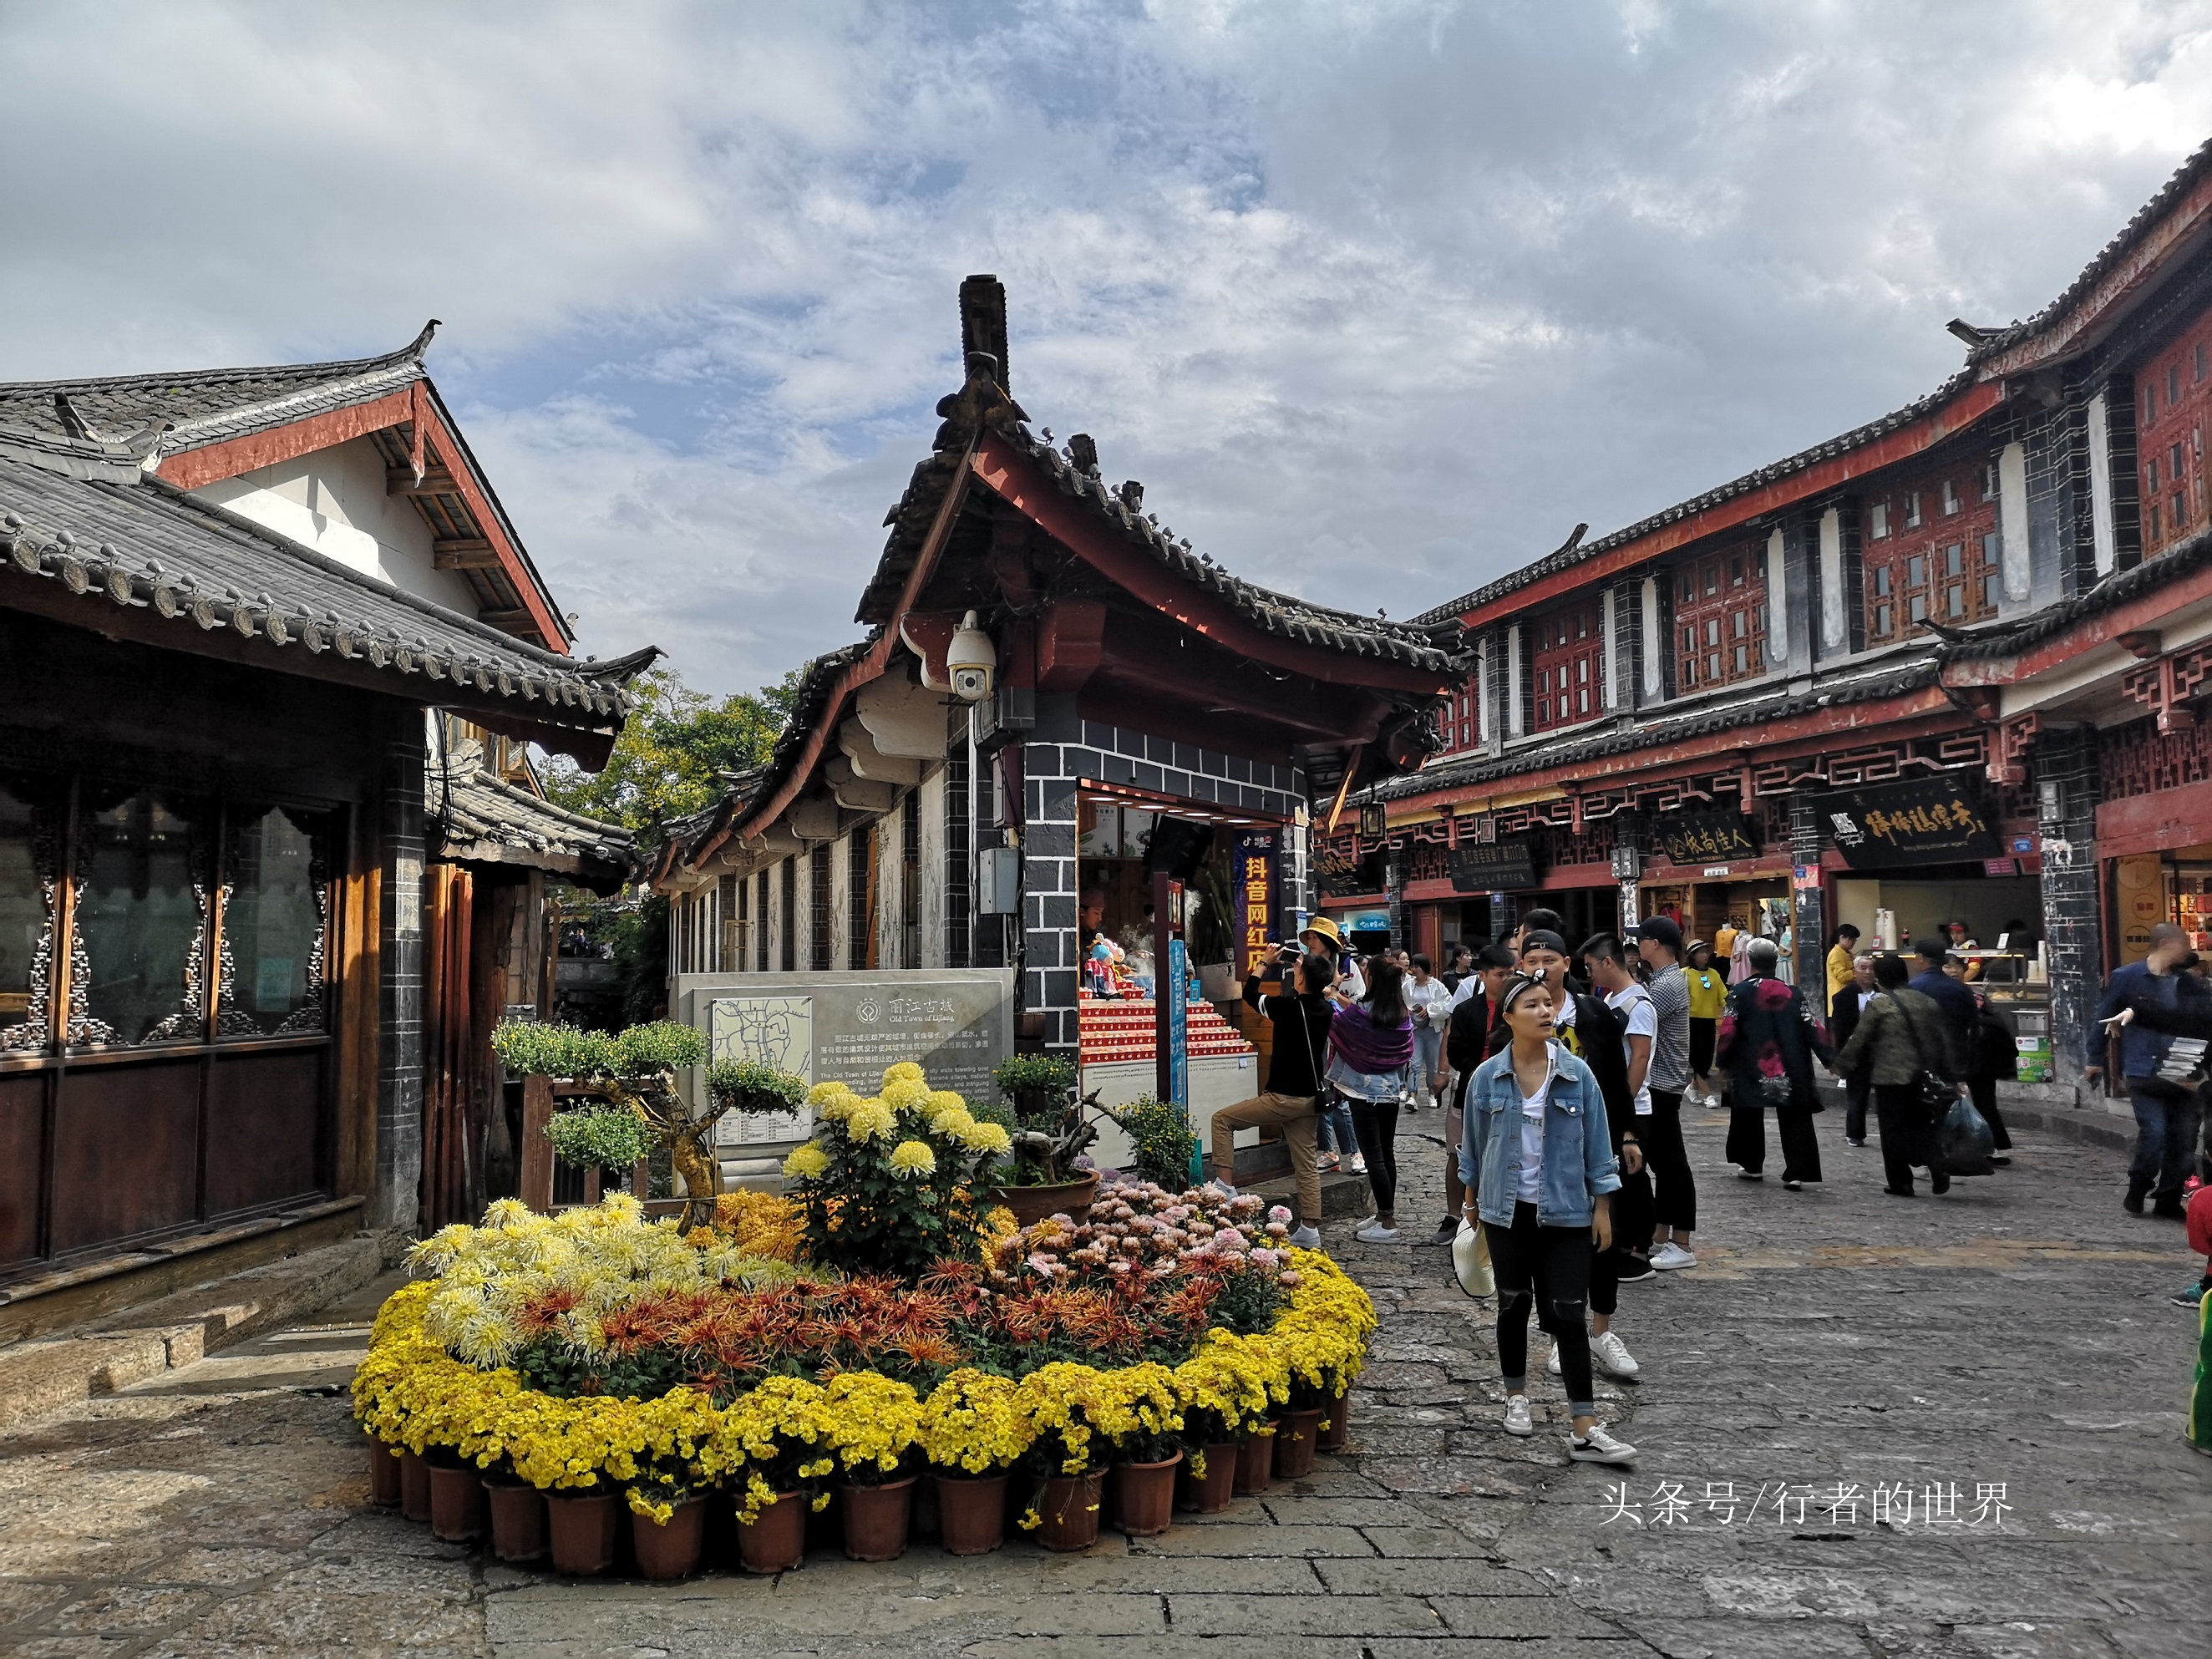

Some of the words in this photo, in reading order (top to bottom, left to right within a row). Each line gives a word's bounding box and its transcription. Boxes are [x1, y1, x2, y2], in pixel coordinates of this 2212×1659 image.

[1246, 856, 1268, 972] 抖音网红店
[888, 997, 955, 1014] 丽江古城
[932, 1014, 955, 1022] Lijiang
